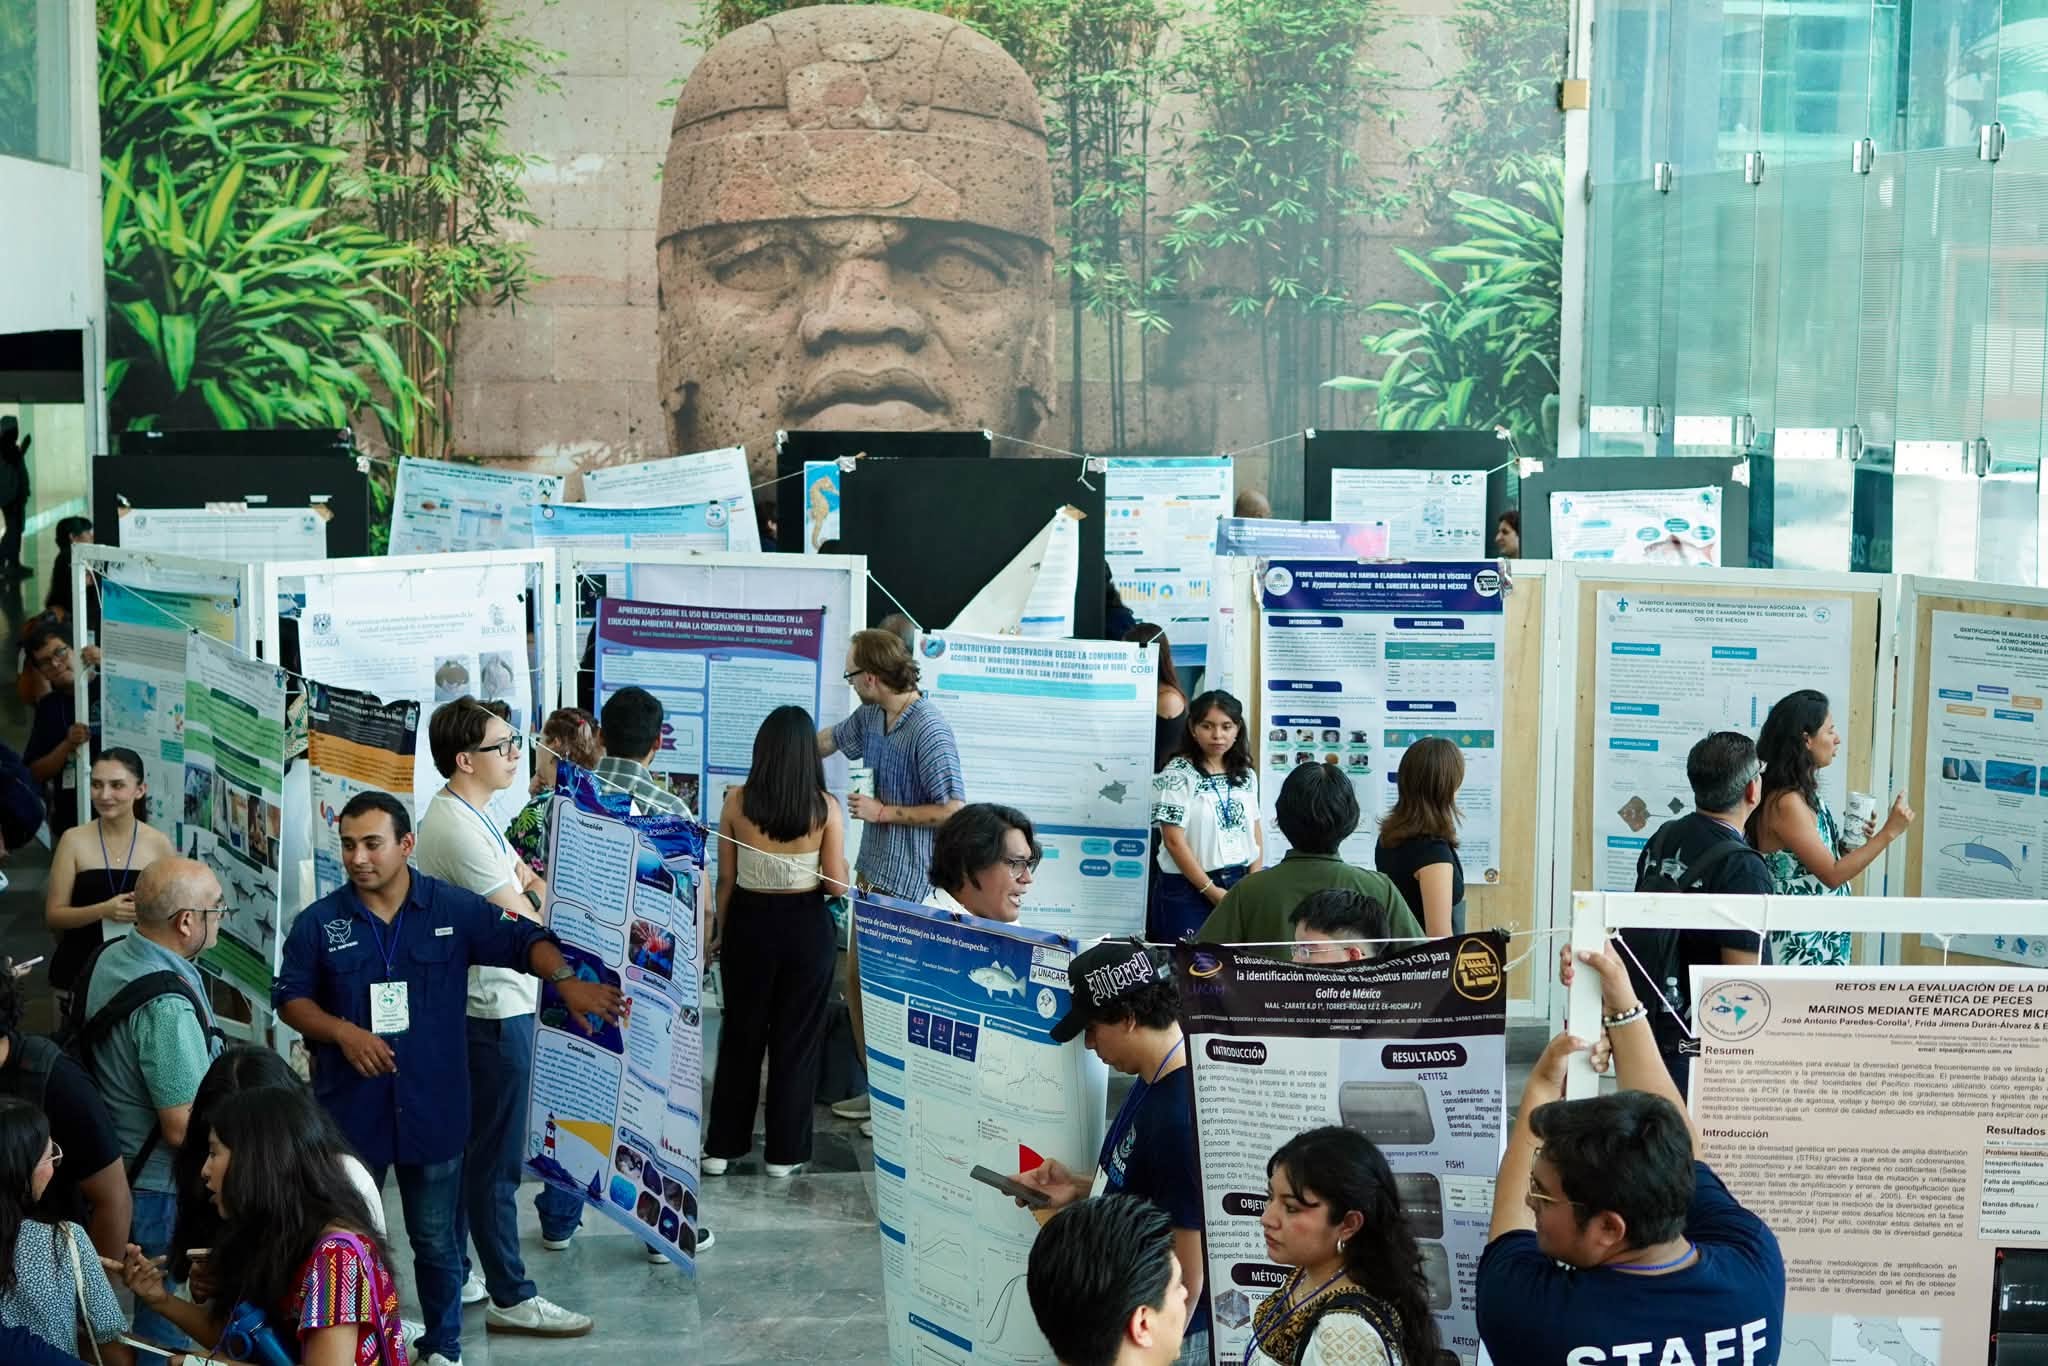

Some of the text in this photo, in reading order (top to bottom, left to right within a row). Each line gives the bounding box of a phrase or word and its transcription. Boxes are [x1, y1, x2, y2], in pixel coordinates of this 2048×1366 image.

[618, 606, 660, 616] APRENDIZAJES
[661, 608, 679, 616] SOBRE
[681, 609, 688, 617] EL
[688, 609, 701, 618] USO
[702, 610, 710, 618] DE
[786, 615, 794, 623] EN
[795, 616, 803, 624] LA
[608, 617, 641, 626] EDUCACIÓN
[641, 619, 673, 628] AMBIENTAL
[675, 621, 691, 629] PARA
[692, 622, 700, 630] LA
[701, 622, 744, 633] CONSERVACIÓN
[746, 625, 754, 633] DE
[755, 625, 788, 635] TIBURONES
[793, 628, 814, 637] RAYAS
[950, 643, 1001, 654] CONSTRUYENDO
[1003, 646, 1053, 657] CONSERVACIÓN
[1056, 650, 1076, 659] DESDE
[1078, 651, 1087, 660] LA
[1130, 665, 1154, 674] COBI
[930, 932, 936, 940] la
[1406, 957, 1412, 966] y
[1412, 953, 1429, 964] COI
[1431, 952, 1450, 964] para
[1038, 968, 1066, 982] UNACAR
[1084, 951, 1154, 1007] Mercy
[1237, 968, 1449, 982] la identificación molecular en el
[1835, 981, 2034, 993] RETOS EN LA EVALUACIÓN DE LA
[1316, 988, 1381, 999] Golfo de México
[1909, 992, 2033, 1005] GENÉTICA DE PECES
[1264, 1002, 1280, 1010] NAAL
[1808, 1005, 1864, 1015] MARINOS
[1868, 1006, 1929, 1016] MEDIANTE
[1933, 1007, 2019, 1018] MARCADORES
[1804, 1017, 1837, 1025] Antonio
[1915, 1020, 1937, 1028] Frida
[1939, 1020, 1970, 1028] Jimena
[1972, 1020, 2032, 1030] Durán-Álvarez
[2034, 1022, 2040, 1030] &
[1212, 1045, 1265, 1060] INTRODUCCIÓN
[1705, 1046, 1754, 1056] Resumen
[1392, 1050, 1457, 1064] RESULTADOS
[1418, 1072, 1448, 1081] AETITS2
[1458, 1088, 1490, 1096] resultados
[1445, 1106, 1456, 1114] por
[1702, 1128, 1768, 1138] Introducción
[1986, 1125, 2046, 1136] Resultados
[1445, 1160, 1465, 1169] FISH1
[1985, 1160, 2044, 1168] Inespecificidades
[1985, 1168, 2020, 1176] superiores
[1210, 1252, 1244, 1260] Campeche
[1455, 1252, 1470, 1260] Fish1
[1996, 1250, 2004, 1259] A
[1566, 1317, 1767, 1366] STAFF
